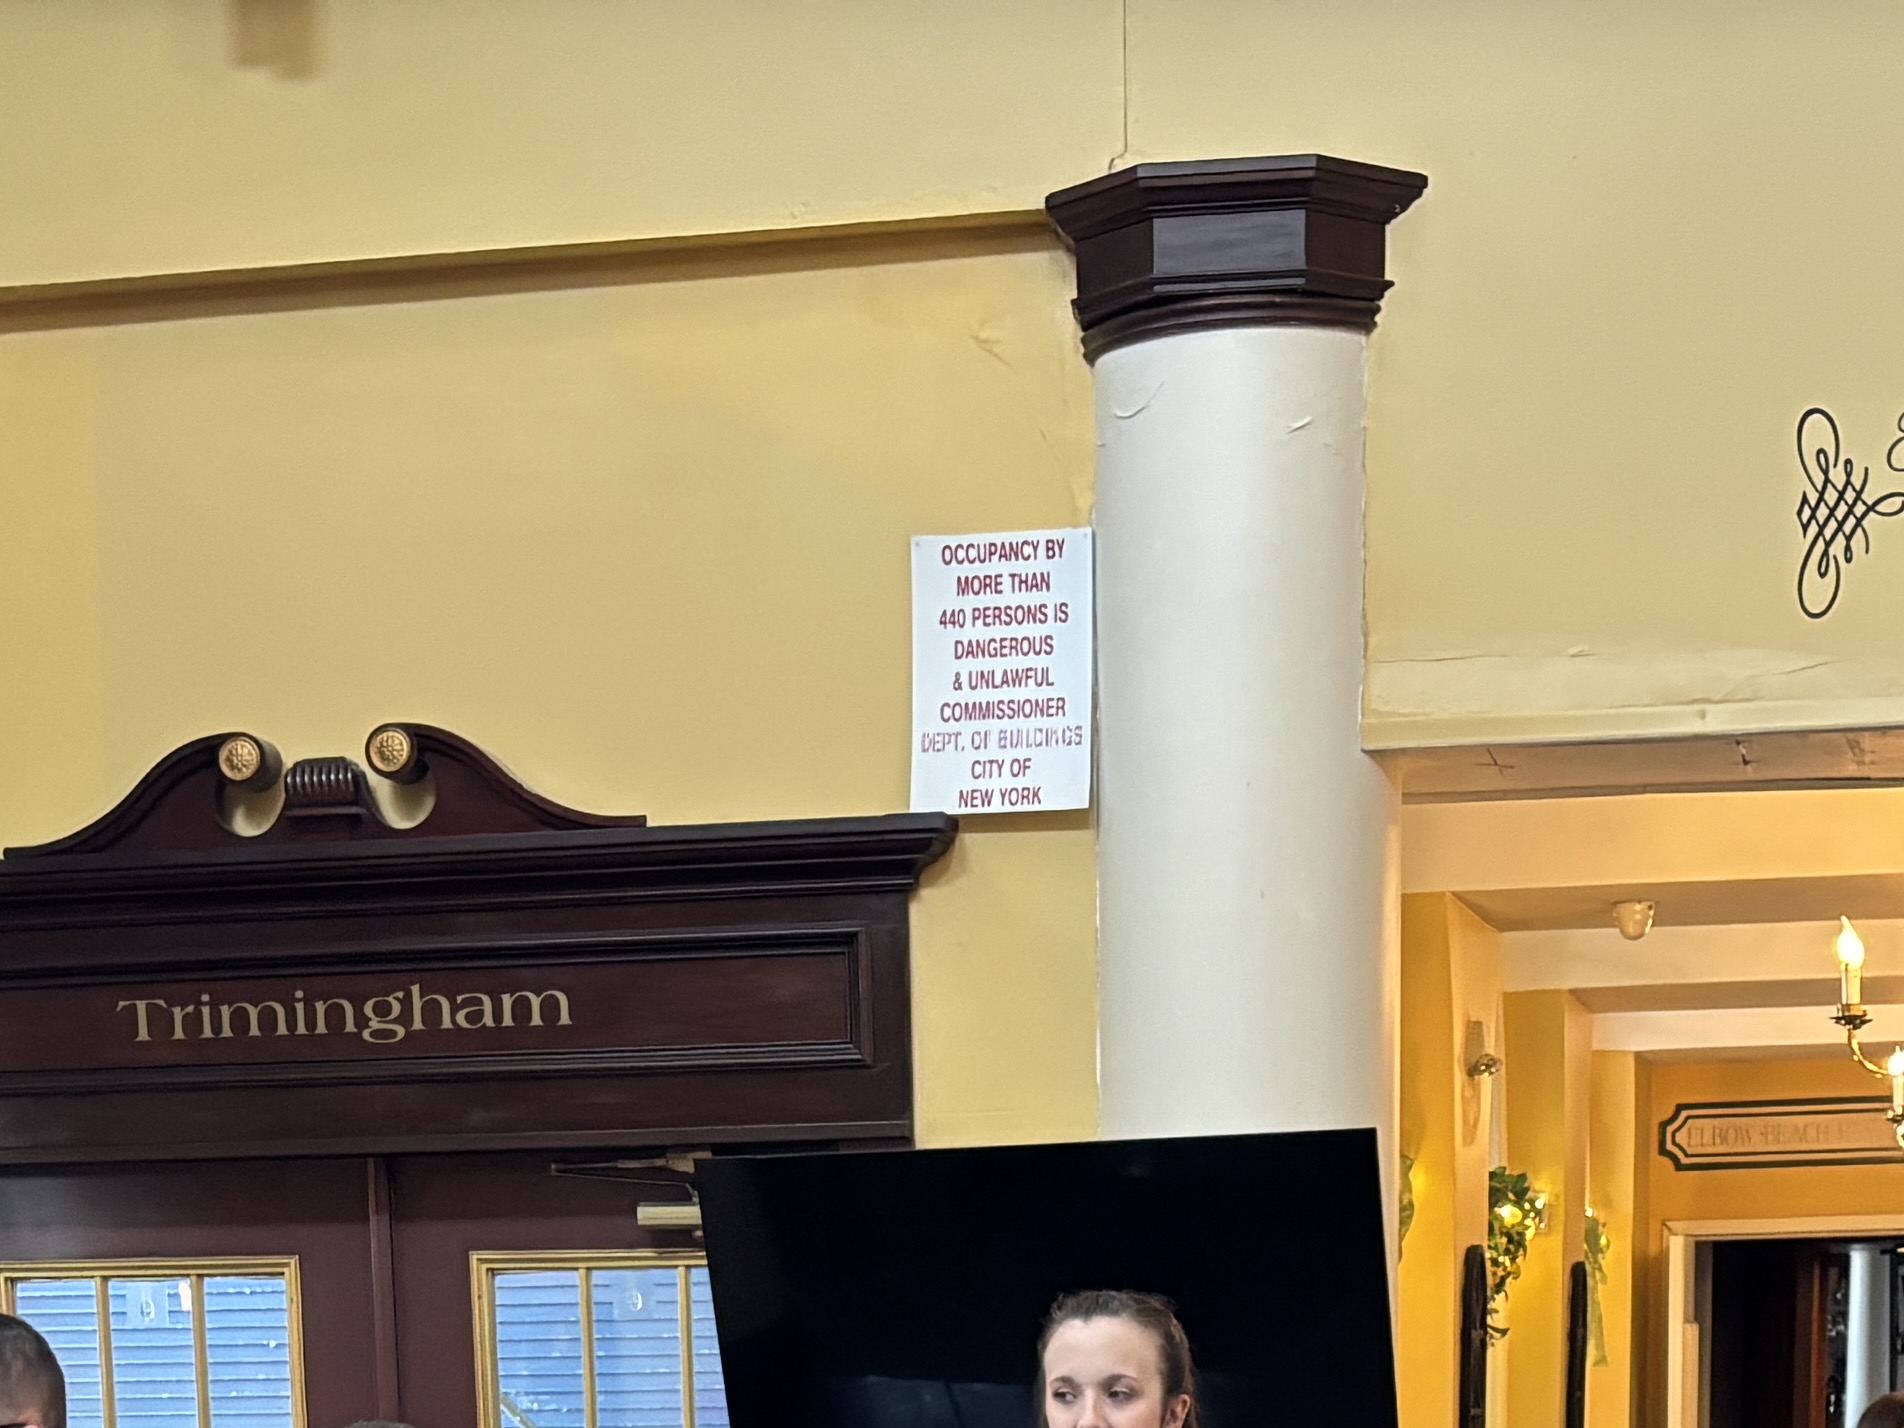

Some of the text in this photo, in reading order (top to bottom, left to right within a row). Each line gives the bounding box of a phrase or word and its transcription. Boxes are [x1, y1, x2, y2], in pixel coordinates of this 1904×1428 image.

[941, 538, 1065, 565] OCCUPANCY BY
[956, 572, 1050, 597] MORE THAN
[939, 603, 1069, 629] 440 PERSONS IS
[954, 635, 1054, 660] DANGEROUS
[953, 667, 1054, 690] & UNLAWFUL
[940, 697, 1066, 723] COMMISSIONER
[971, 758, 1031, 779] CITY OF
[958, 787, 1041, 808] NEW YORK
[116, 984, 573, 1043] Trimingham
